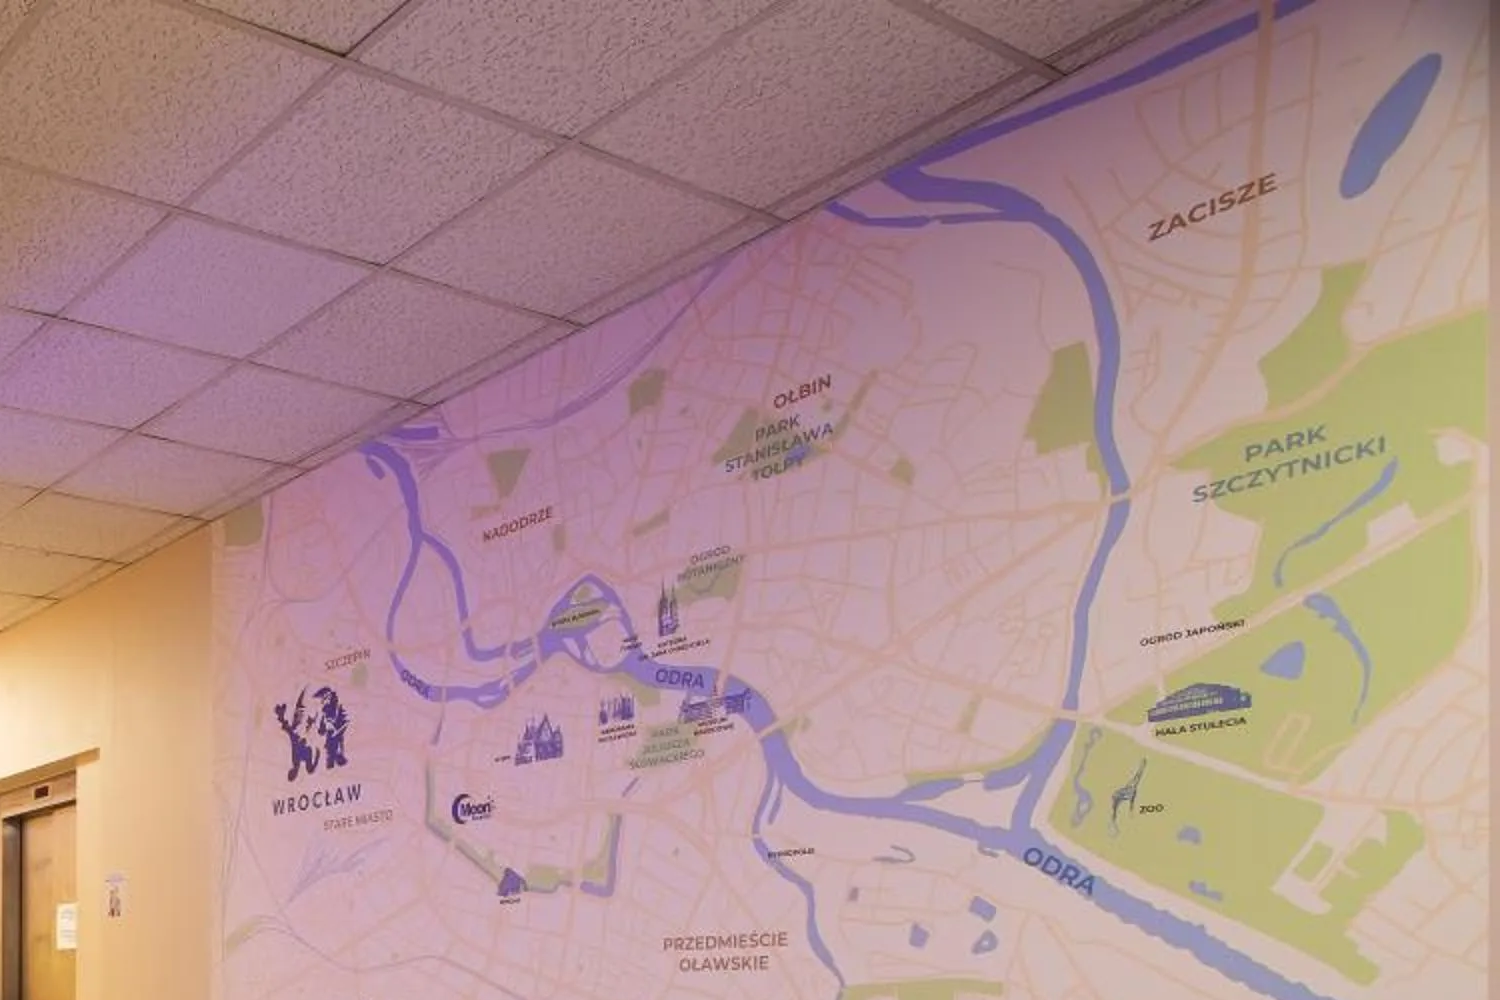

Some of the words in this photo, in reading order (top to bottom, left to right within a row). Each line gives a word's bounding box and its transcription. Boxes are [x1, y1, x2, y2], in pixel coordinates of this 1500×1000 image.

[1146, 172, 1278, 242] ZACISZE
[755, 414, 801, 441] PARK
[1244, 424, 1328, 463] PARK
[1191, 435, 1387, 503] SZCZYTNICKI
[655, 668, 705, 689] ODRA
[1138, 803, 1165, 815] ZOO
[1023, 846, 1098, 898] ODRA
